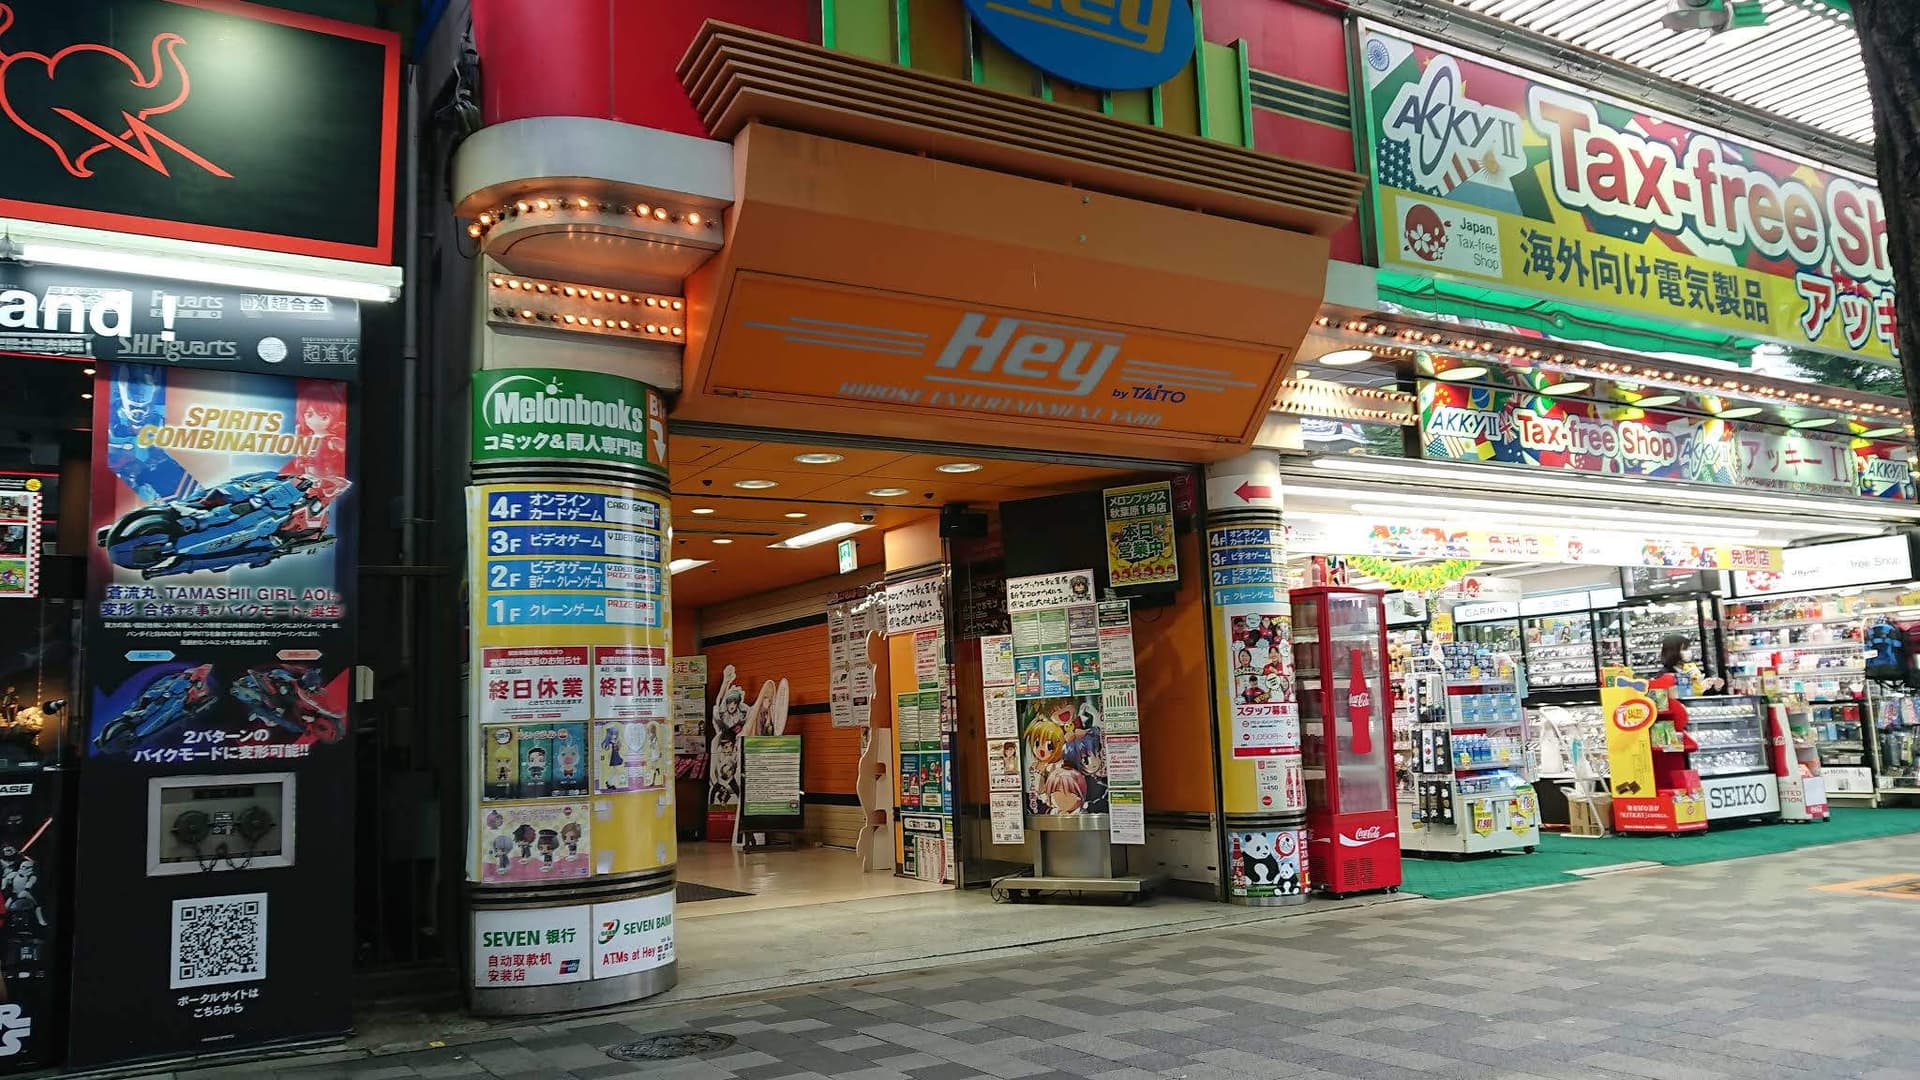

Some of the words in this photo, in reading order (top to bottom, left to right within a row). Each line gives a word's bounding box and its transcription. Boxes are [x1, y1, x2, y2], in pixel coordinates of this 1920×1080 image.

[1540, 101, 1820, 253] Tax-free
[1459, 217, 1496, 238] Japan.
[1456, 234, 1498, 256] Tax-free
[1473, 252, 1499, 271] Shop
[1520, 226, 1770, 325] 海外向け電気製品
[932, 311, 1122, 397] Hey
[1112, 387, 1129, 400] by
[494, 391, 644, 433] Melonbooks
[838, 381, 921, 405] HIROSE
[928, 389, 1104, 422] ENTERTAINMENT
[1110, 409, 1163, 427] YARD
[184, 406, 284, 432] SPIRITS
[137, 424, 321, 457] COMBINATION!
[484, 432, 644, 459] コミック&同人専門店
[1623, 426, 1676, 462] Shop
[529, 493, 591, 507] オンライン
[1109, 490, 1167, 507] メロンブックス
[490, 495, 522, 520] 4F
[529, 508, 603, 522] カードゲーム
[1109, 502, 1167, 519] 秋葉原1号店
[1122, 520, 1154, 542] 本日
[1229, 528, 1264, 538] オンライン
[490, 530, 522, 554] 3F
[530, 532, 603, 548] ビデオゲーム
[1210, 533, 1227, 547] 4F
[1229, 537, 1270, 545] カードゲーム
[1118, 538, 1165, 560] 営業中
[1230, 551, 1271, 561] ビデオゲーム
[1211, 552, 1228, 566] 3F
[1731, 549, 1771, 567] 免税店
[529, 560, 603, 575] ビデオゲーム
[1231, 567, 1272, 576] ビデオゲーム
[490, 565, 522, 588] 2F
[529, 575, 604, 588] 音ゲー・クレーンゲーム
[1213, 571, 1228, 586] 2F
[166, 586, 250, 601] TAMASHII
[257, 587, 297, 601] GIRL
[1214, 591, 1230, 604] 1F
[1232, 591, 1274, 600] クレーンゲーム
[490, 599, 522, 623] 1F
[529, 604, 605, 617] クレーンゲーム
[607, 599, 633, 609] PRIZE
[1464, 606, 1509, 619] GARMIN
[488, 677, 584, 701] 終日休業
[599, 676, 664, 698] 終日休業
[1236, 704, 1291, 717] スタッフ募集!
[184, 729, 269, 744] 2パターンの
[134, 744, 309, 763] バイクモードに変形可能!!
[1710, 783, 1767, 810] SEIKO
[1355, 826, 1381, 840] Coca-Cola
[623, 920, 655, 936] SEVEN
[483, 930, 540, 948] SEVEN
[545, 928, 577, 944] 银行
[488, 952, 552, 967] 自动取款机
[602, 951, 629, 966] ATMs
[631, 949, 640, 961] at
[642, 947, 656, 958] Hey
[488, 970, 526, 982] 安装店
[177, 988, 259, 1007] ポータルサイトは
[193, 1003, 244, 1018] こちらから
